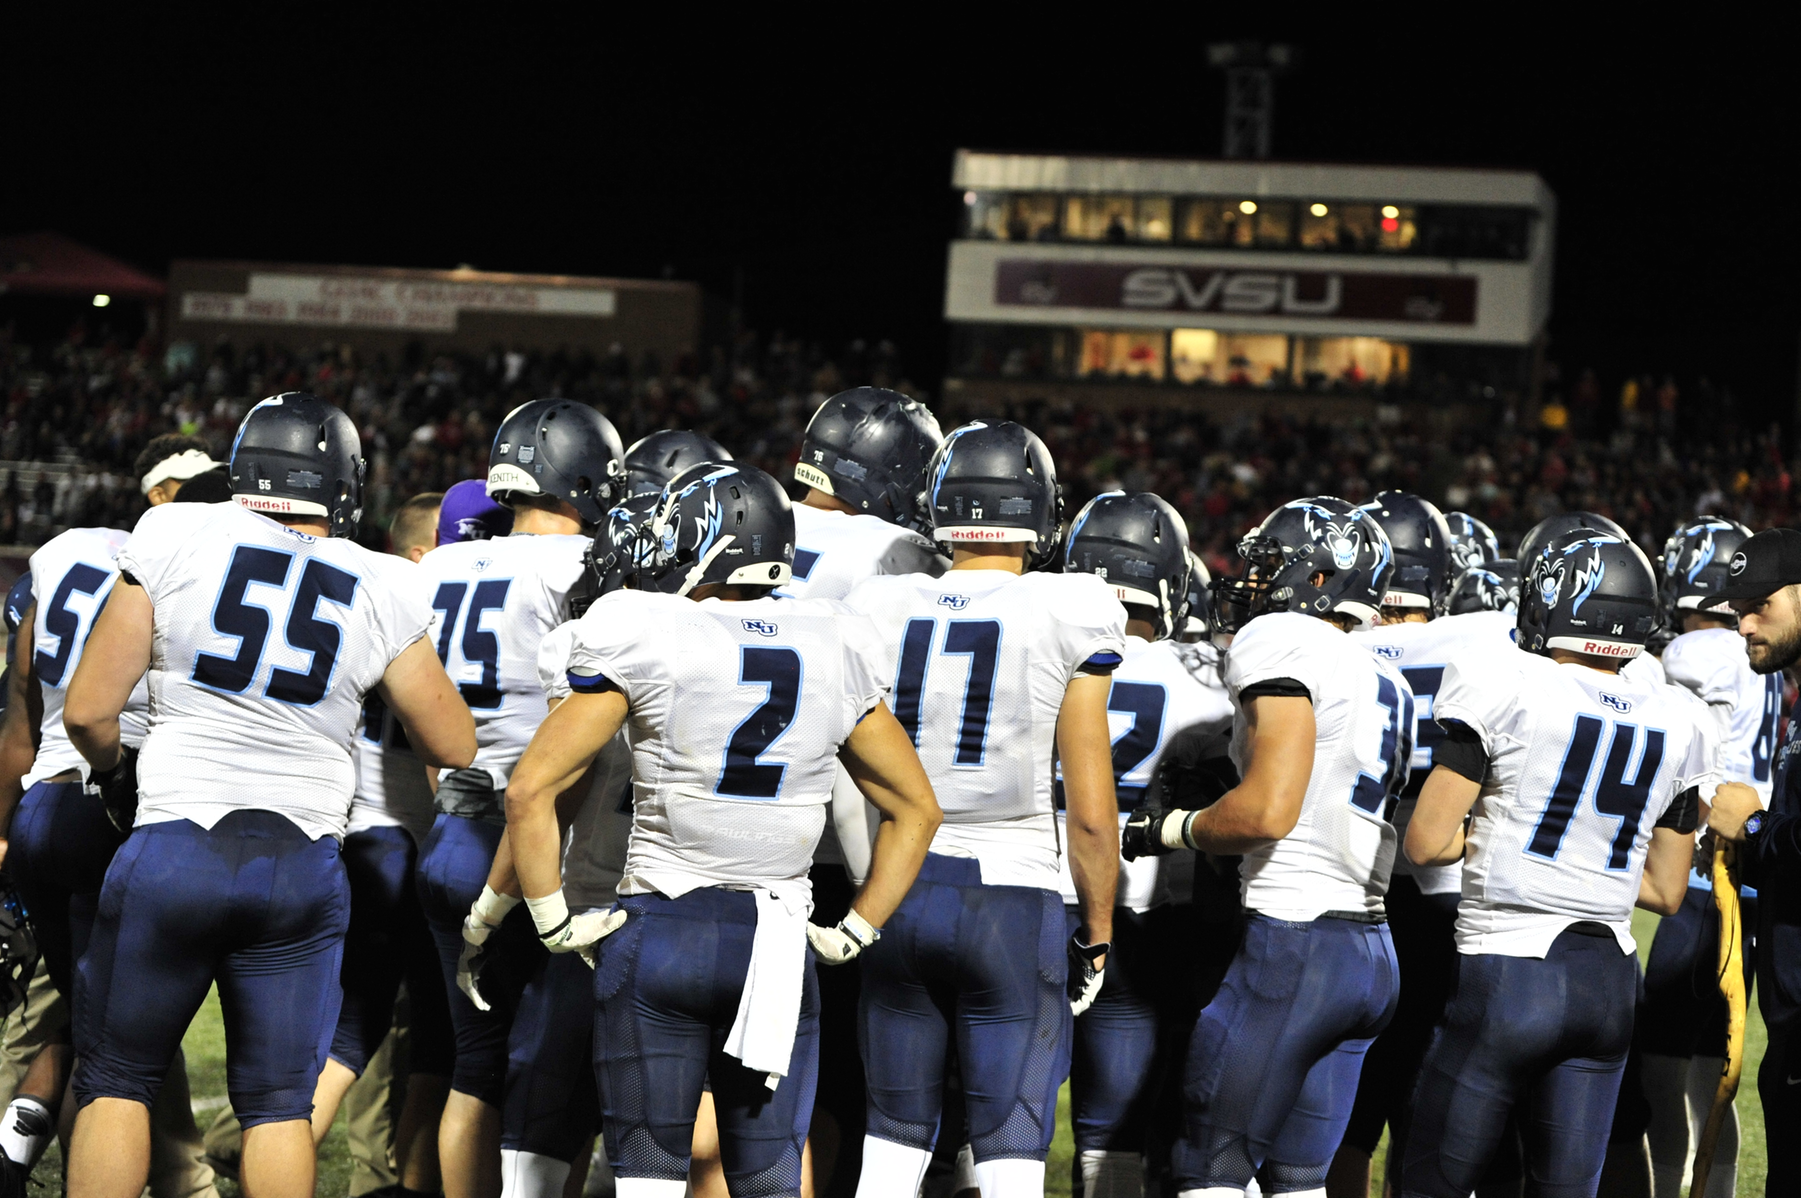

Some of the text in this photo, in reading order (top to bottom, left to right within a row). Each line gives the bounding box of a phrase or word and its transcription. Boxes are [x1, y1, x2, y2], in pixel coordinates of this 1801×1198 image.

[1121, 269, 1343, 312] SVSU
[258, 479, 271, 490] 55
[490, 472, 519, 484] ENITH
[797, 467, 824, 486] schutt
[241, 497, 291, 511] Riddell
[971, 508, 983, 519] 17
[951, 530, 1005, 540] Riddell
[939, 595, 969, 610] NU
[35, 560, 117, 689] 5
[189, 544, 361, 708] 55
[743, 620, 777, 636] NU
[1611, 623, 1624, 635] 14
[431, 576, 514, 711] 75
[1583, 642, 1637, 656] Riddell
[892, 617, 1004, 767] 17
[1600, 692, 1631, 713] NU
[713, 645, 804, 800] 2
[1523, 712, 1667, 872] 14
